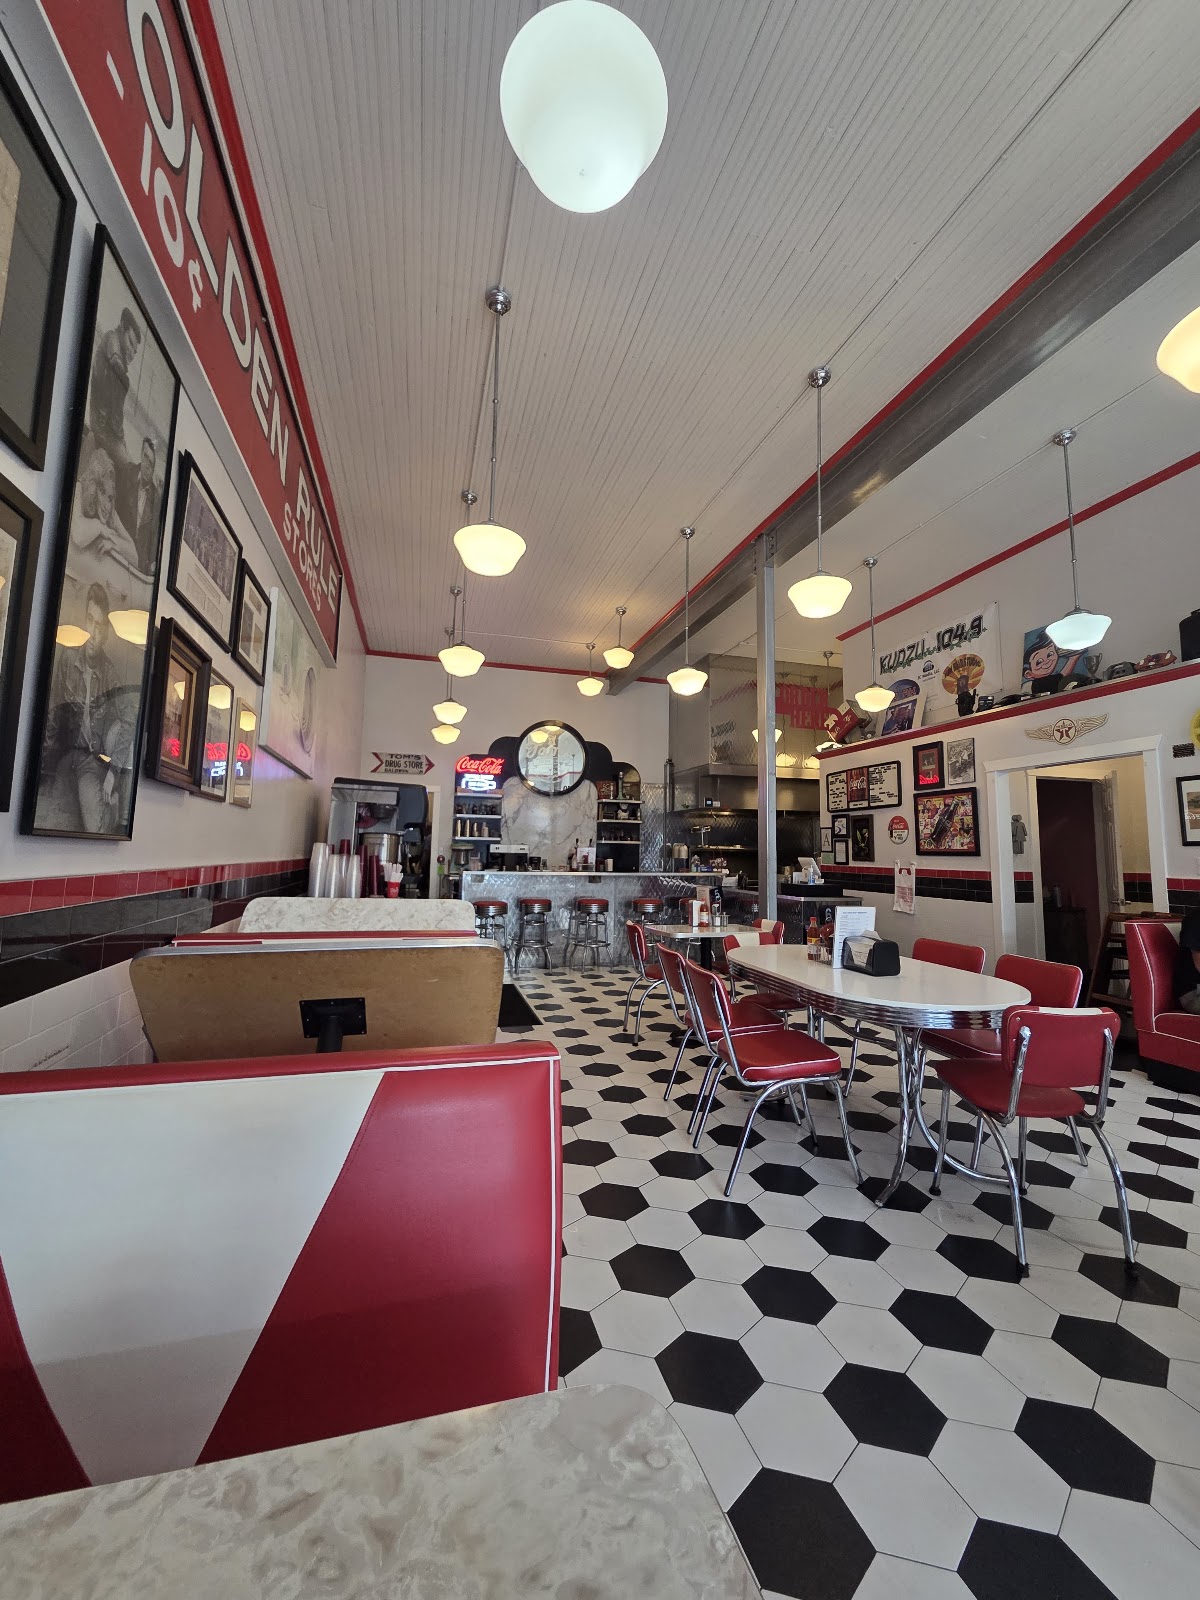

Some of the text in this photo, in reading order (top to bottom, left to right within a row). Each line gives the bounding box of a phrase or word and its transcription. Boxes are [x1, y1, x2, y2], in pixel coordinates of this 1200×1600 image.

[283, 502, 322, 611] STORES
[296, 466, 338, 615] RULE
[880, 638, 926, 675] KUDZU
[936, 614, 983, 653] 104.9
[385, 760, 424, 769] DRUG STORE
